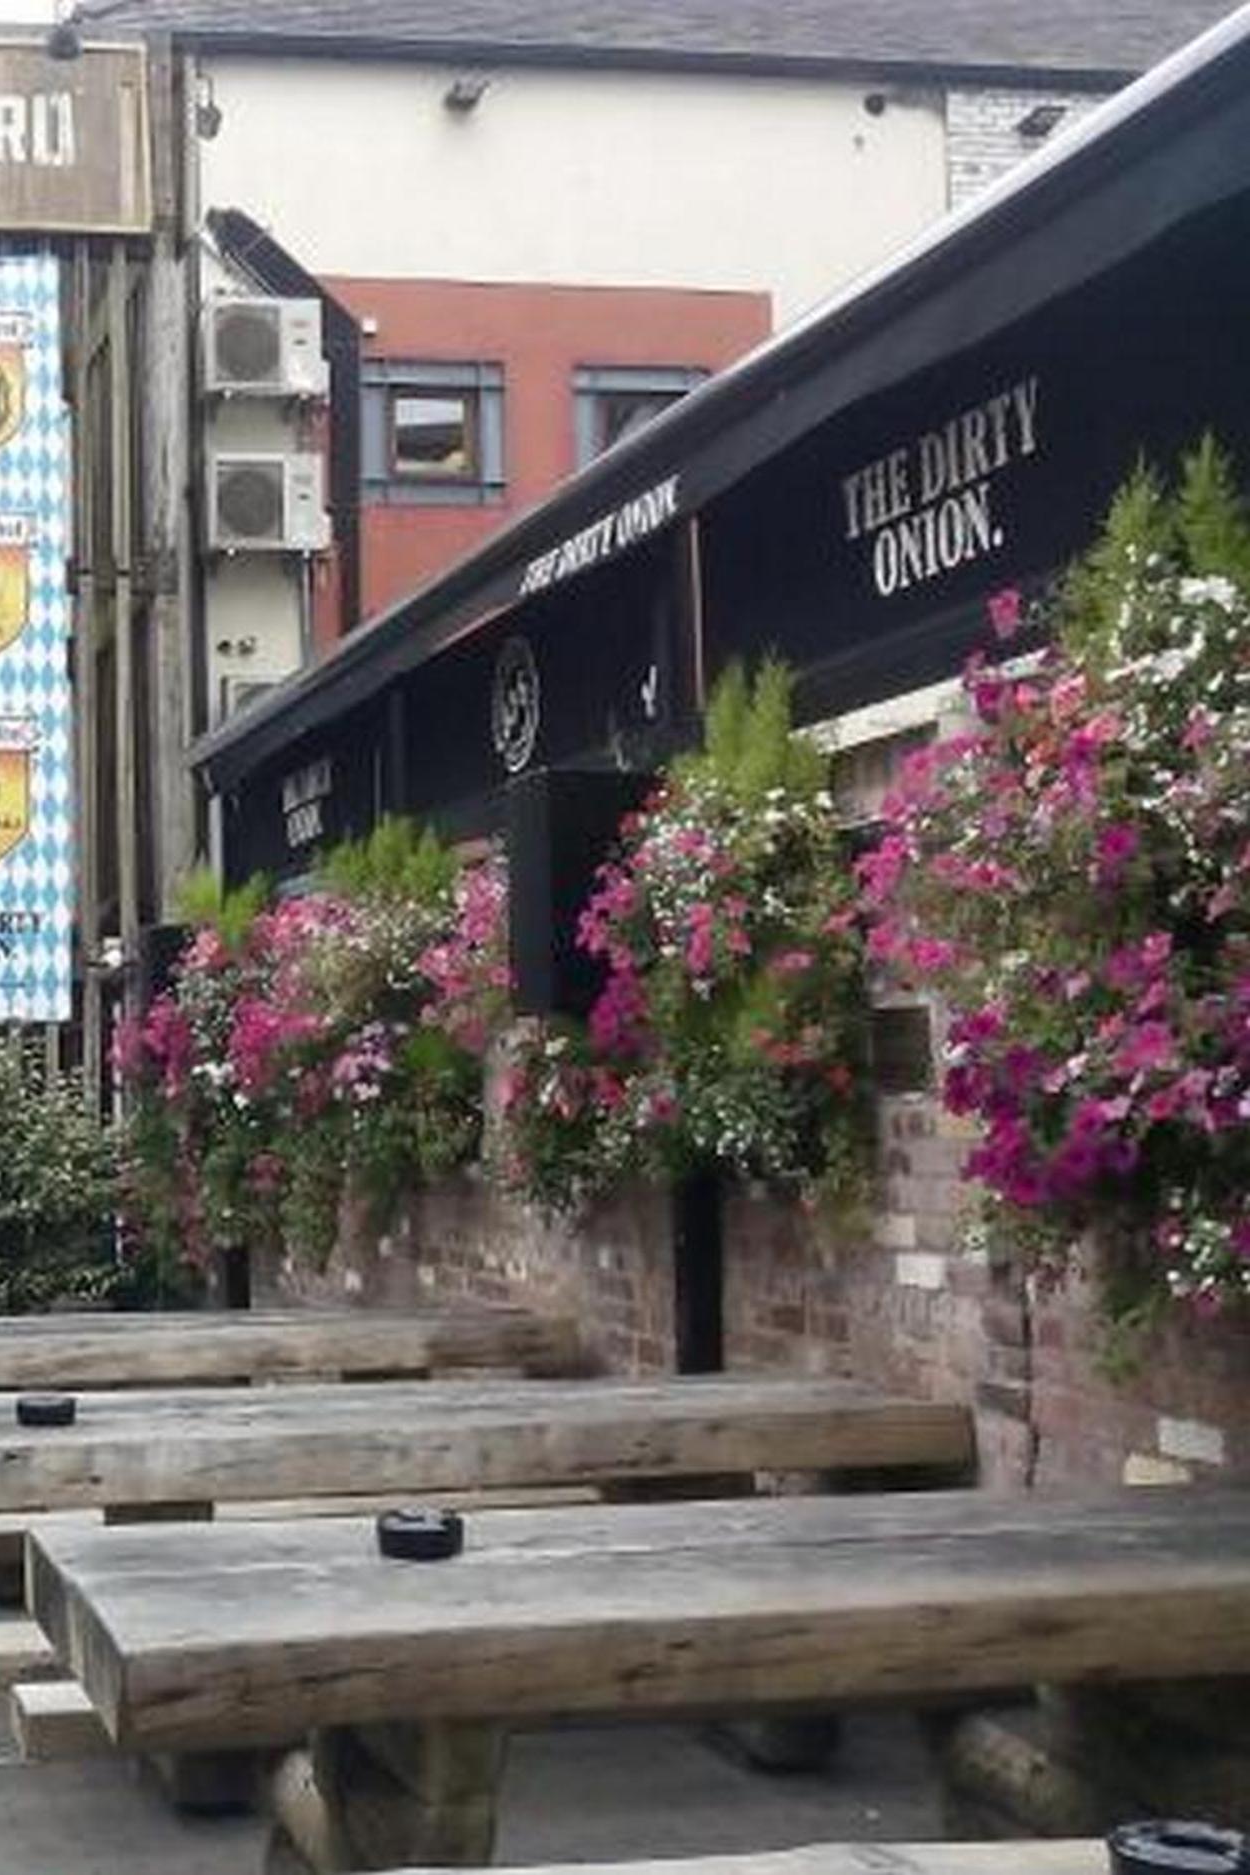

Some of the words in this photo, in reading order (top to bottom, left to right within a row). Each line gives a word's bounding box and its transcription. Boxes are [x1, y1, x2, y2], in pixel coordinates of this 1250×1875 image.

[844, 449, 912, 539] THE
[918, 376, 1038, 504] DIRTY
[874, 482, 1004, 597] ONION.
